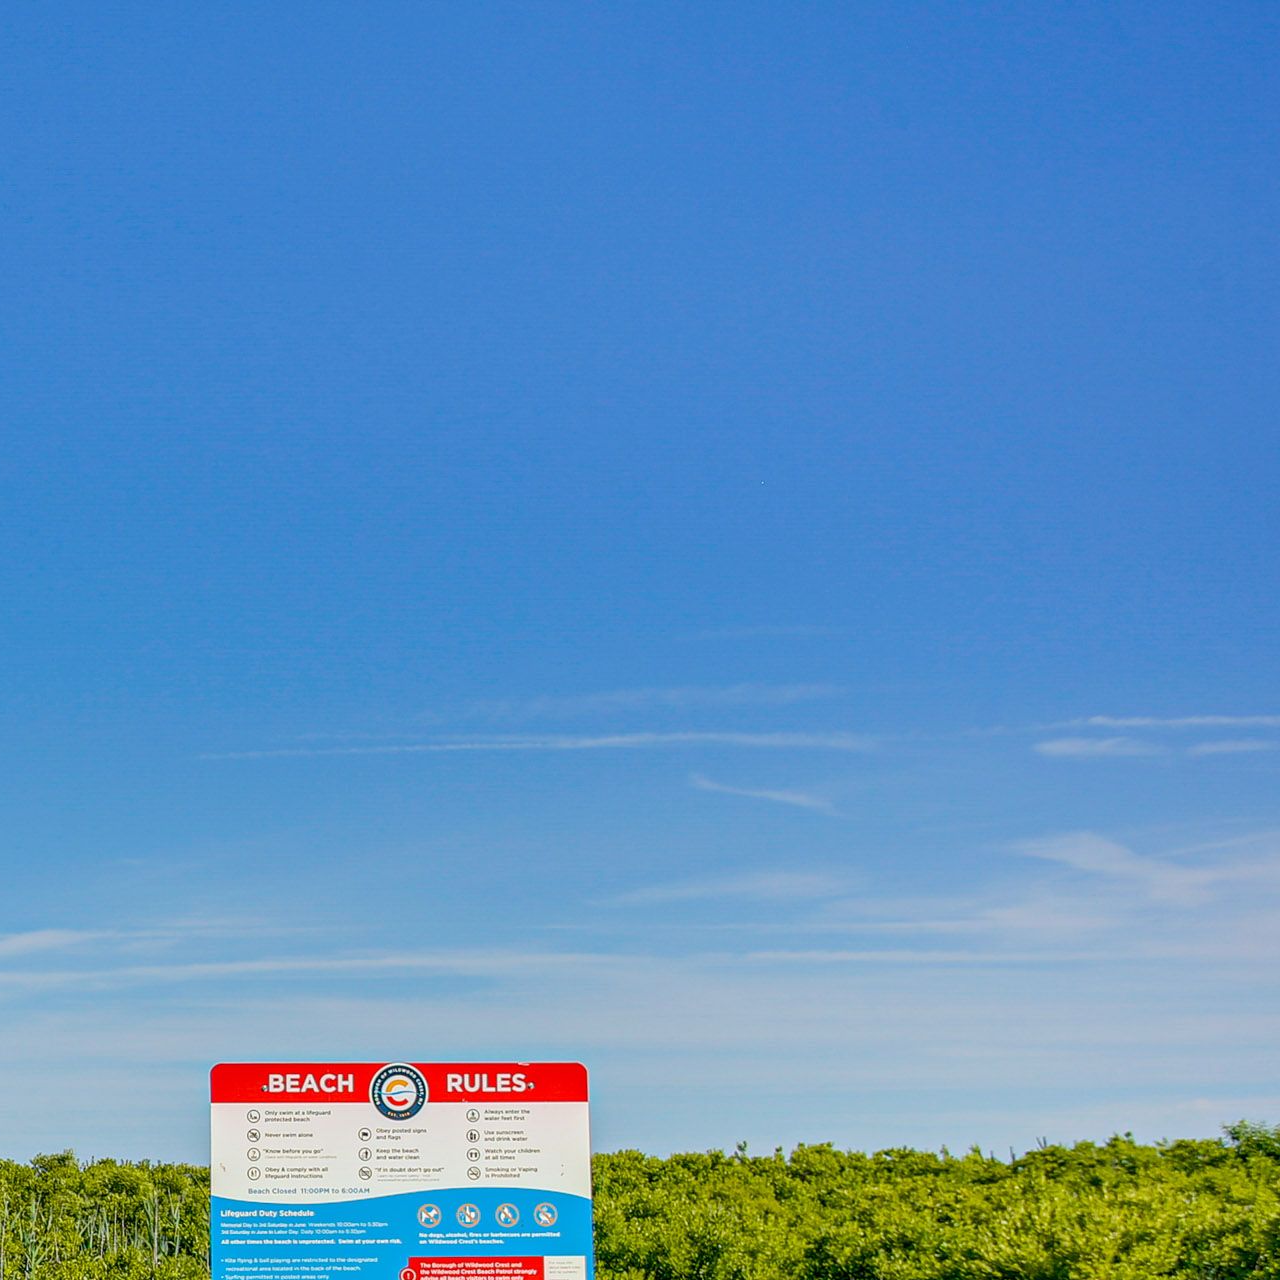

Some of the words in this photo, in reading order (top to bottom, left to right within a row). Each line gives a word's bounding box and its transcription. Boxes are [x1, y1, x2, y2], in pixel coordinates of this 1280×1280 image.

[269, 1073, 354, 1093] BEACH
[446, 1073, 527, 1093] RULES
[221, 1210, 257, 1218] Lifeguard
[259, 1210, 277, 1218] Duty
[279, 1210, 315, 1218] Schedule
